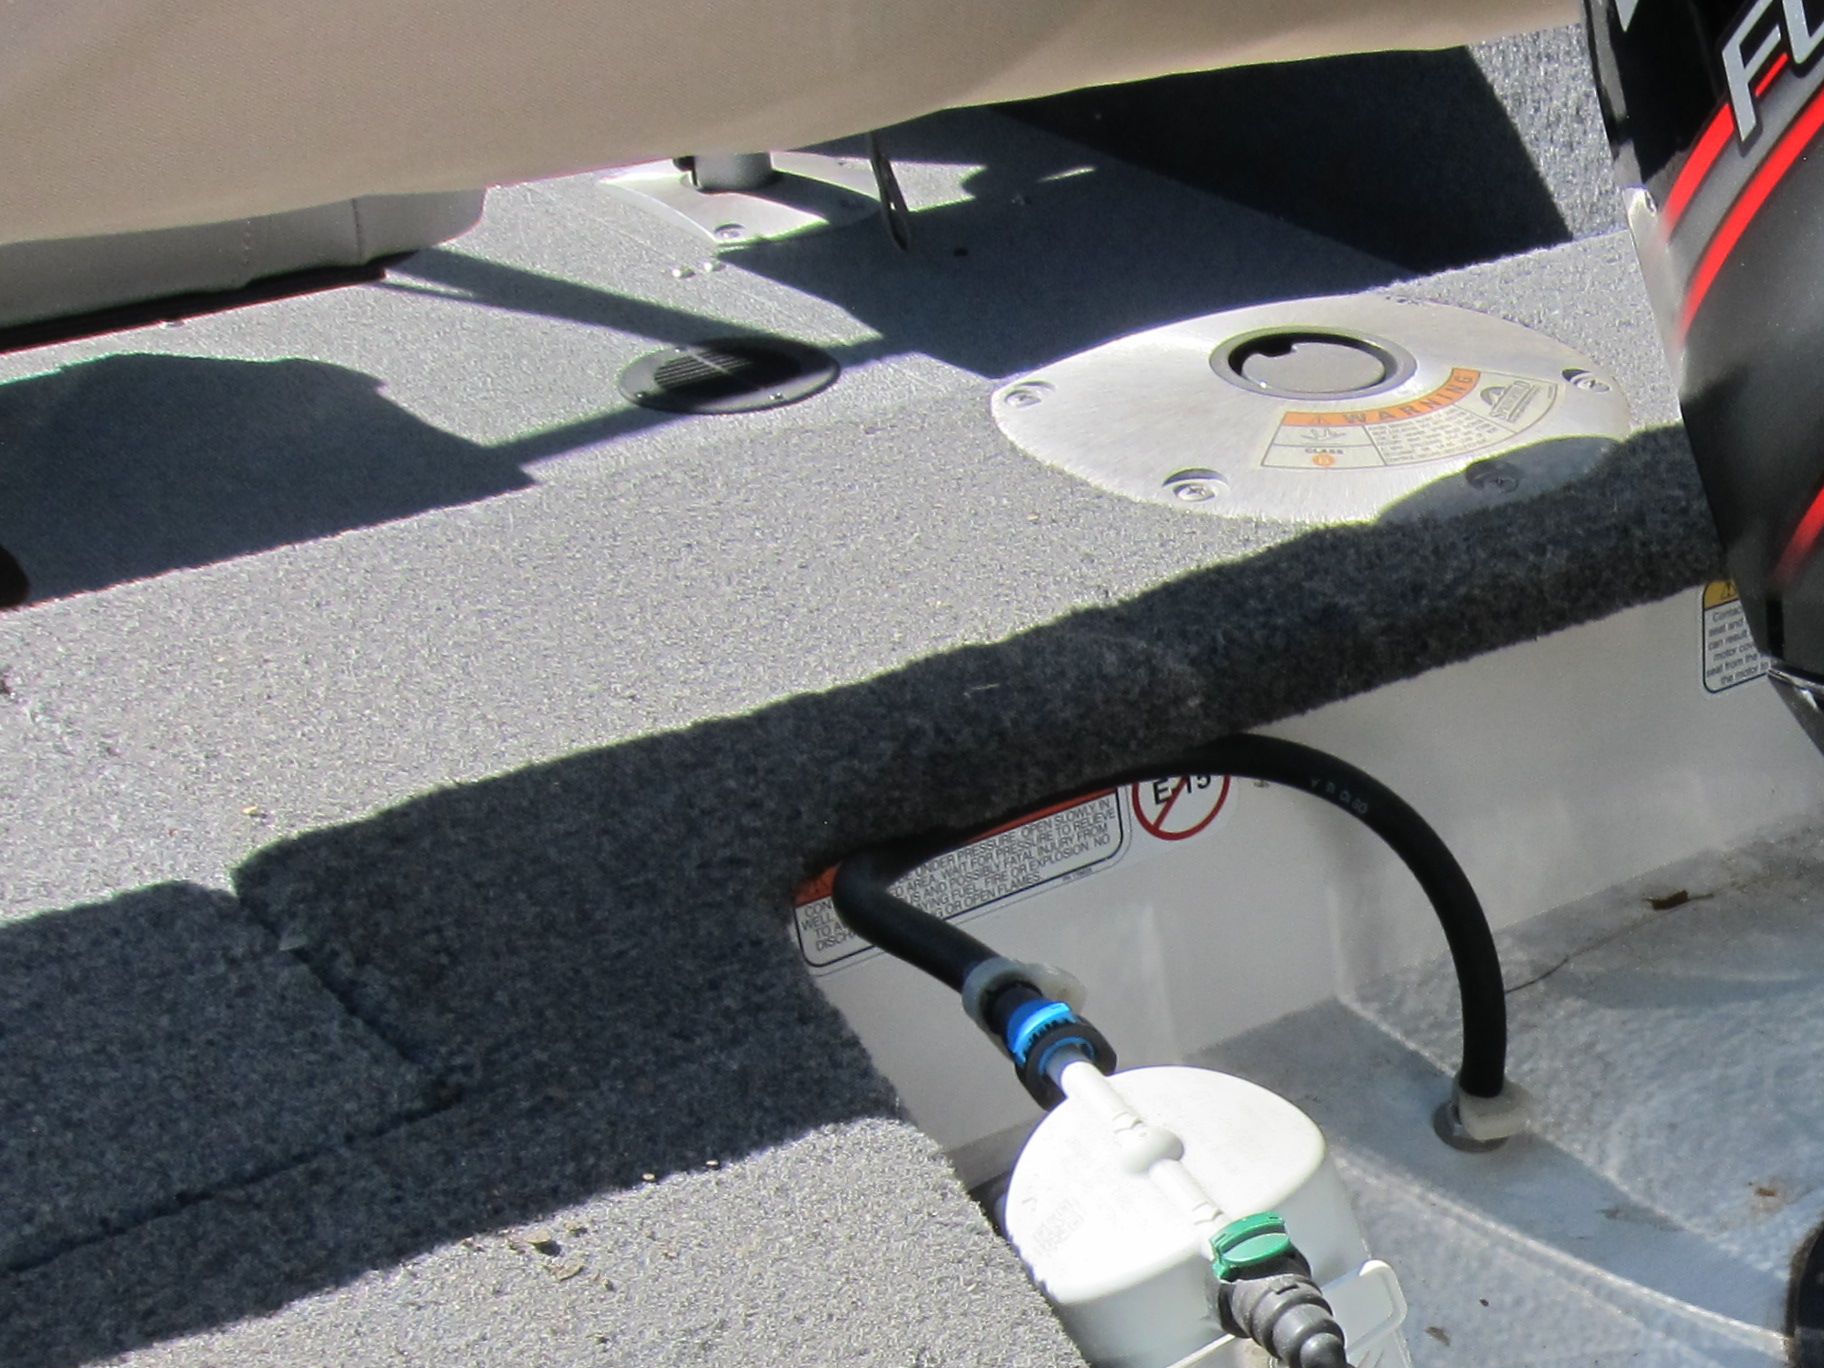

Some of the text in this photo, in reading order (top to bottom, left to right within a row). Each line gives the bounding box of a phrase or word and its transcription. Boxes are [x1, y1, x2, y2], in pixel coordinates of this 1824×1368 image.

[1342, 375, 1474, 422] WARNING
[915, 854, 954, 876] UNDER
[1021, 819, 1053, 838] OPEN
[1054, 803, 1096, 823] SLOWLY
[923, 881, 947, 897] AND
[949, 861, 999, 889] POSSIBLY
[1003, 851, 1033, 868] FATAL
[1076, 822, 1108, 841] FROM
[941, 862, 967, 879] WAIT
[970, 852, 993, 869] FOR
[996, 832, 1053, 859] PRESSURE
[1056, 824, 1072, 837] TO
[1073, 808, 1116, 830] RELIEVE
[1093, 833, 1111, 848] NO
[964, 889, 997, 908] OPEN
